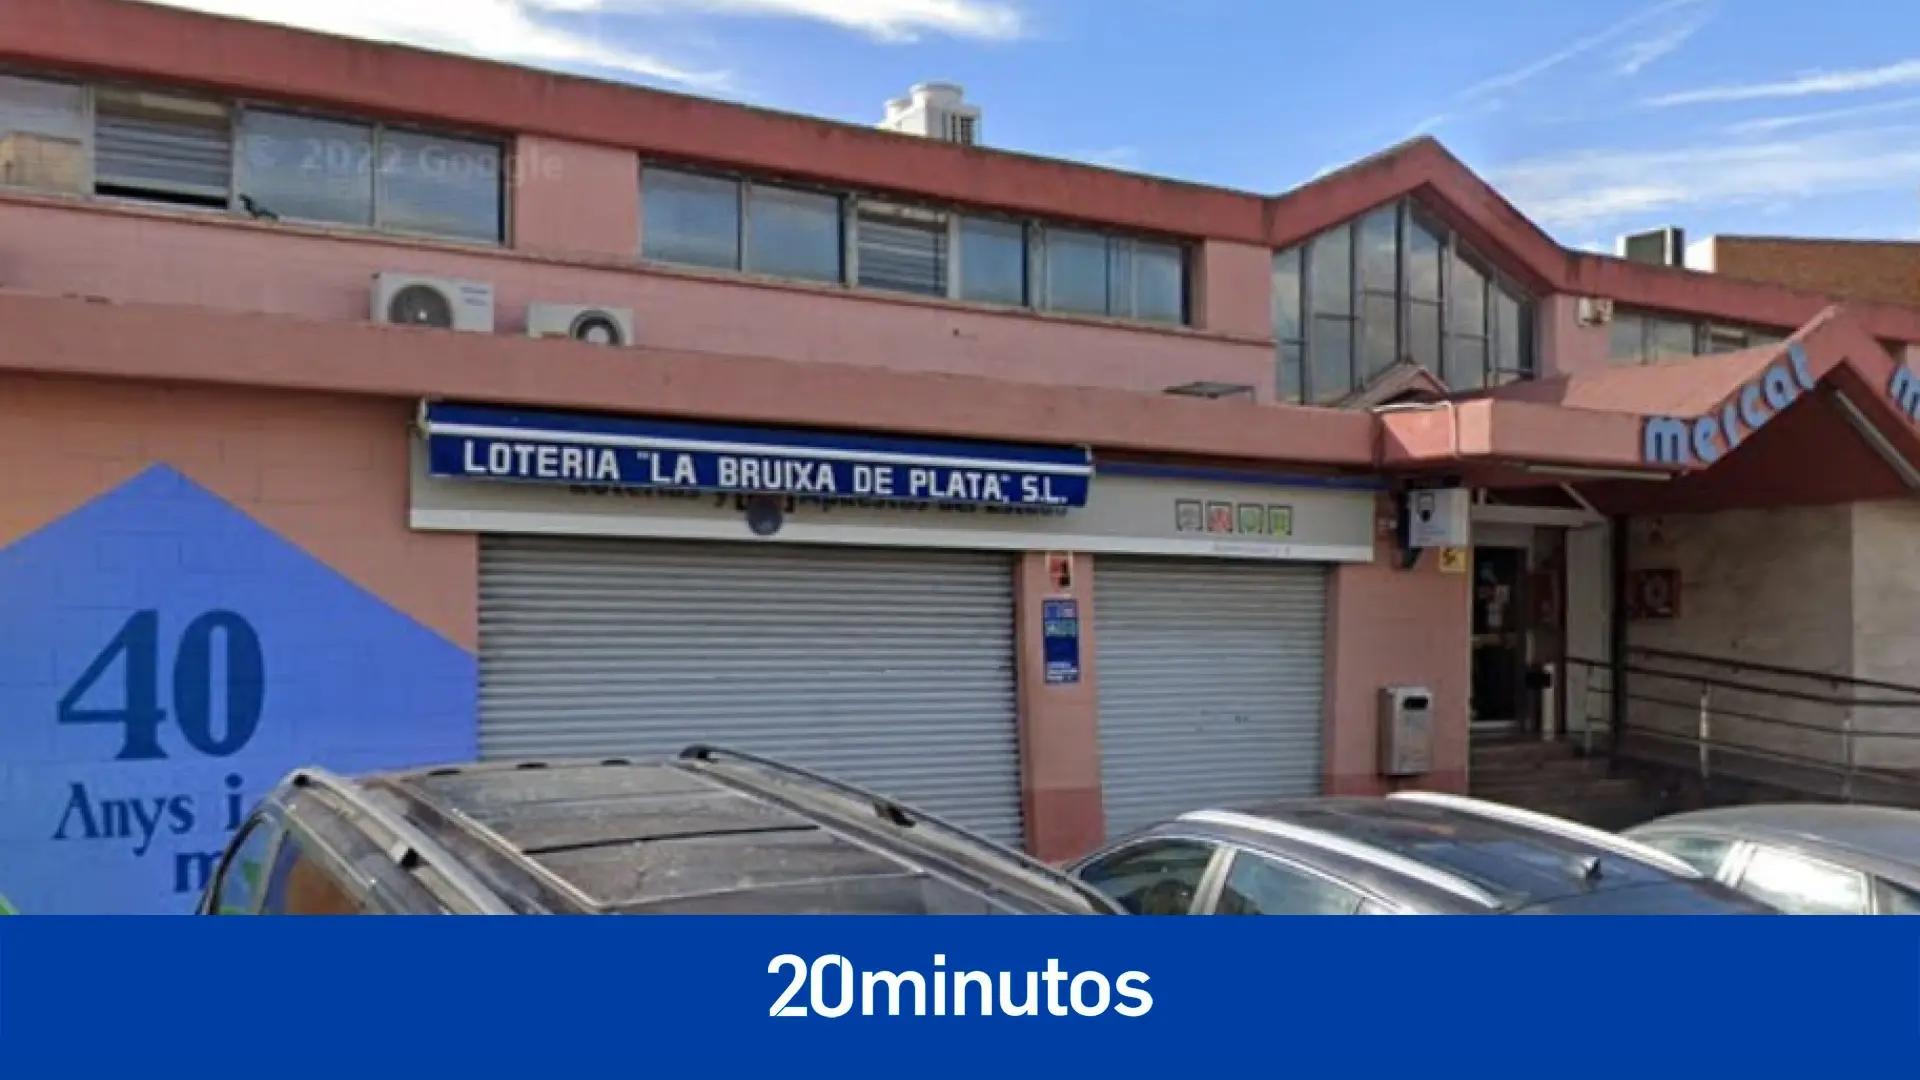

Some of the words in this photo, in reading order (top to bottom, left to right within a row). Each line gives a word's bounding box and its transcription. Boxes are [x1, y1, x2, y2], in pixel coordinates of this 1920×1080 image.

[1643, 339, 1815, 465] mercat
[464, 440, 620, 479] LOTERIA
[718, 456, 836, 491] BRUIXA
[853, 465, 893, 494] DE
[1021, 476, 1068, 504] S.L.
[57, 608, 265, 760] 40
[53, 781, 195, 857] Anys
[225, 773, 243, 831] i
